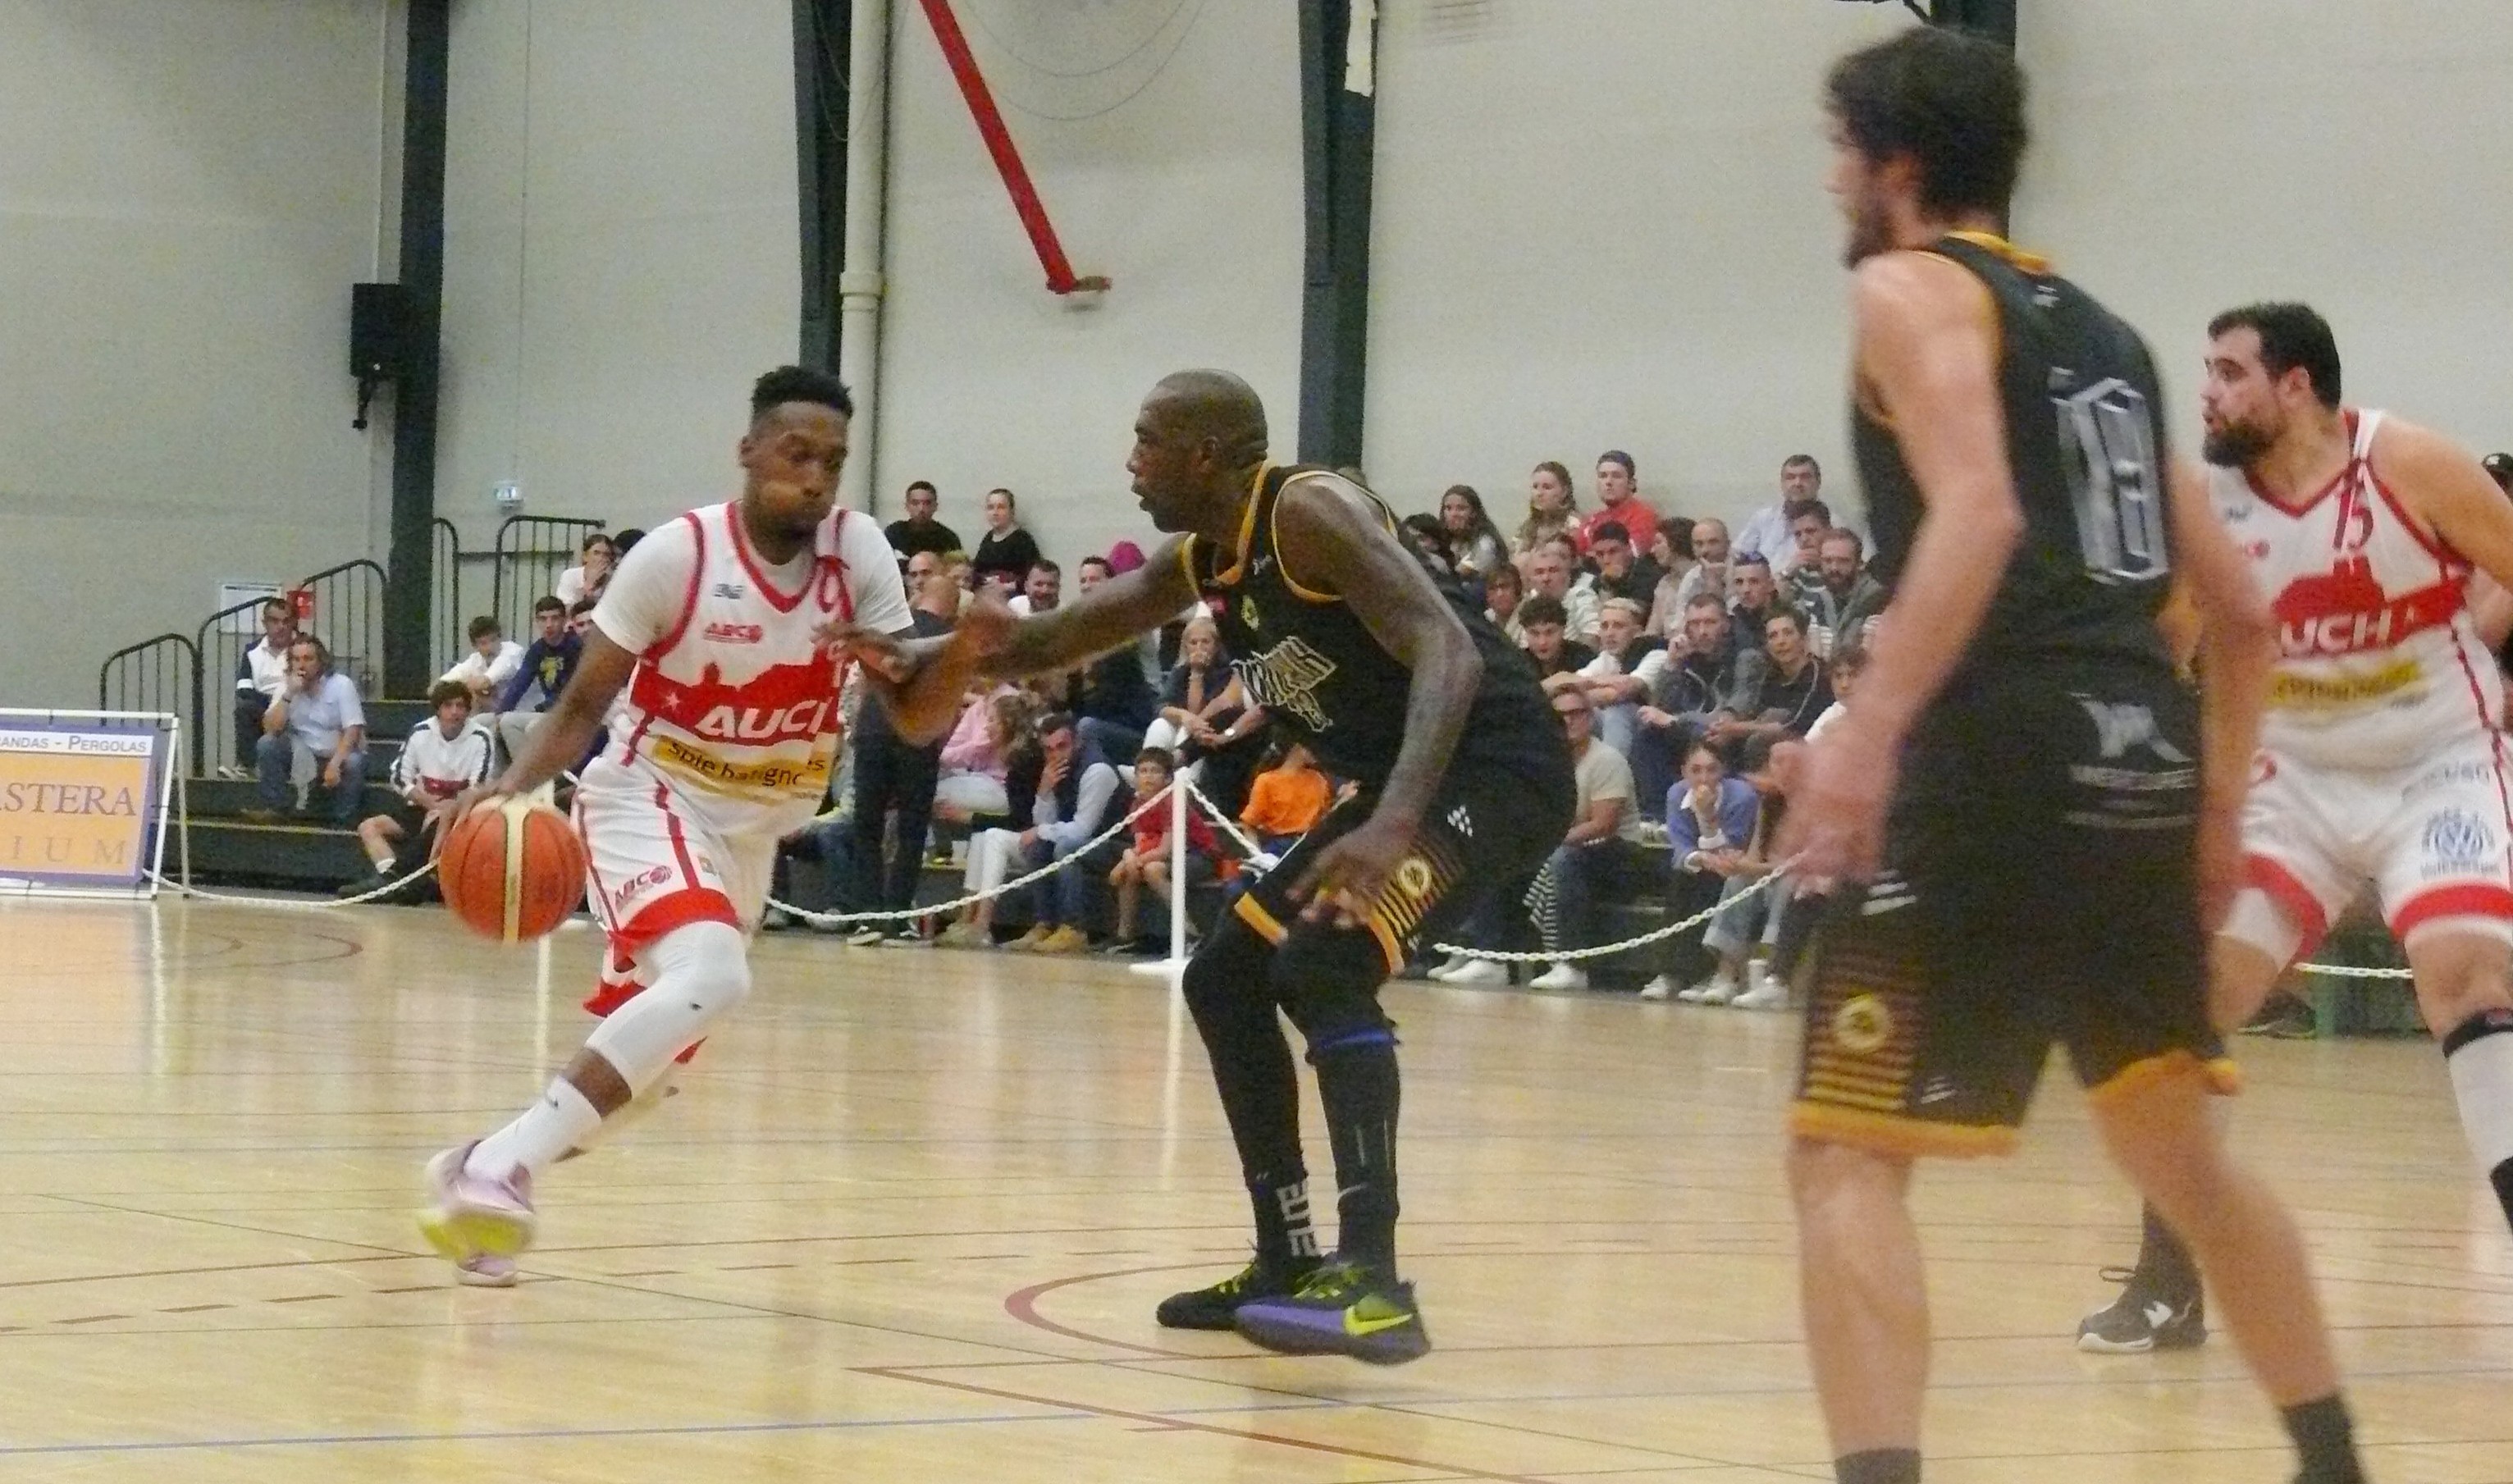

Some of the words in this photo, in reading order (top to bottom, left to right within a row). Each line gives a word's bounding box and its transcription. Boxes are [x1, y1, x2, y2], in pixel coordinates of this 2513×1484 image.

[2280, 609, 2393, 654] UCH
[68, 735, 147, 753] PERGOLAS
[0, 782, 136, 816] STERA
